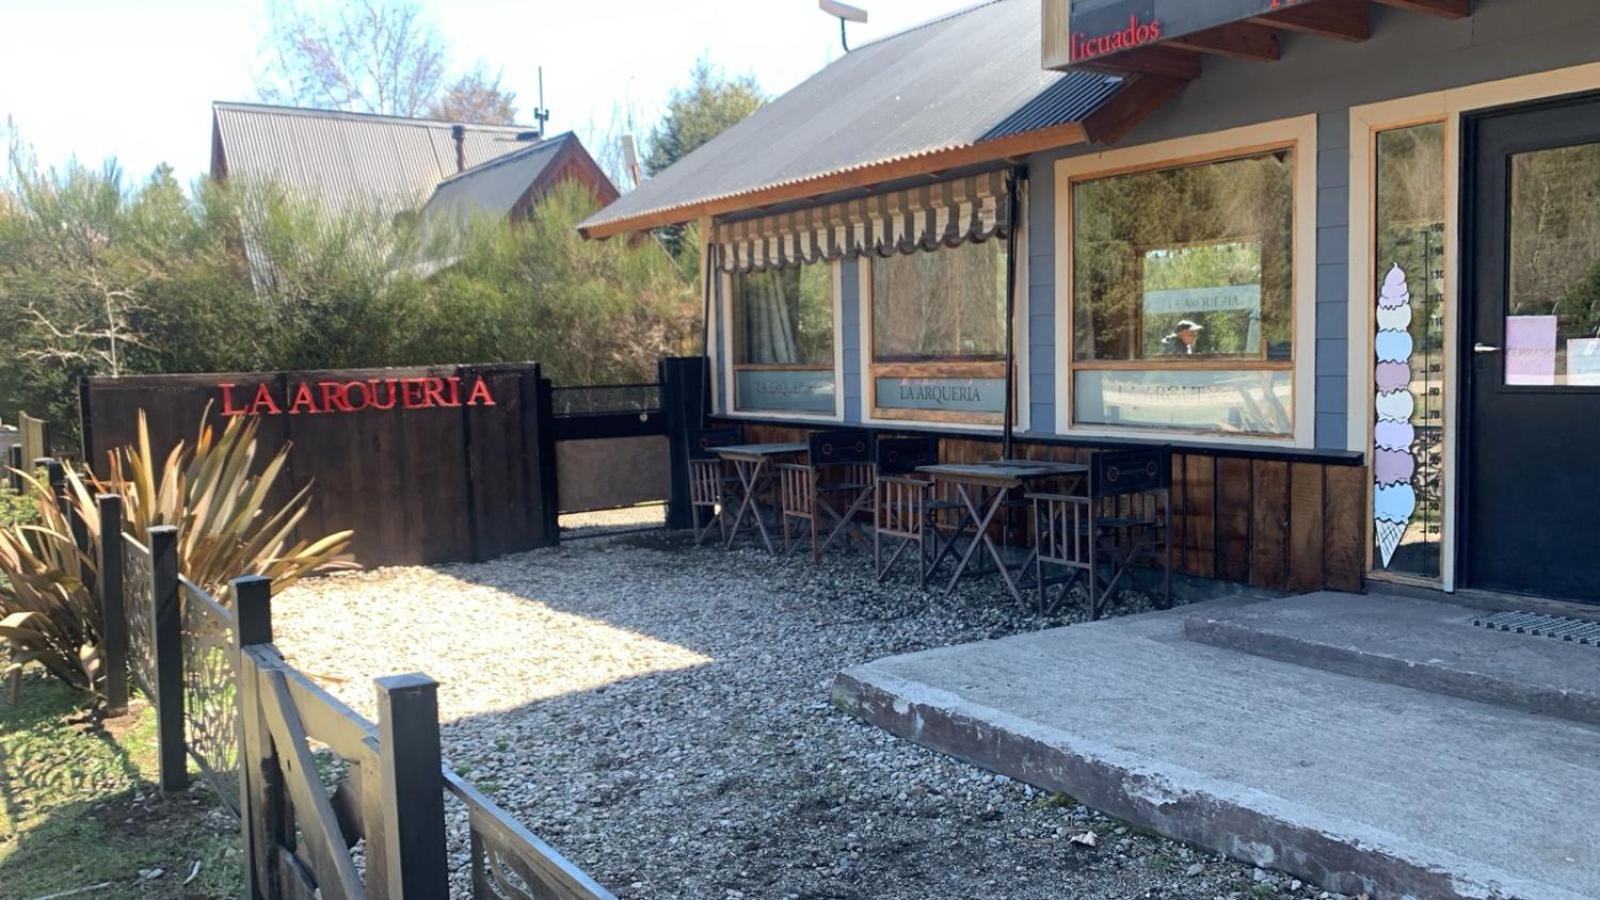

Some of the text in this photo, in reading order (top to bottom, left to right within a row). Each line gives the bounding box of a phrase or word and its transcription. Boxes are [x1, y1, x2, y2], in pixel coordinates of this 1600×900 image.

[218, 383, 282, 415] LA
[899, 385, 981, 404] LA ARQUERIA
